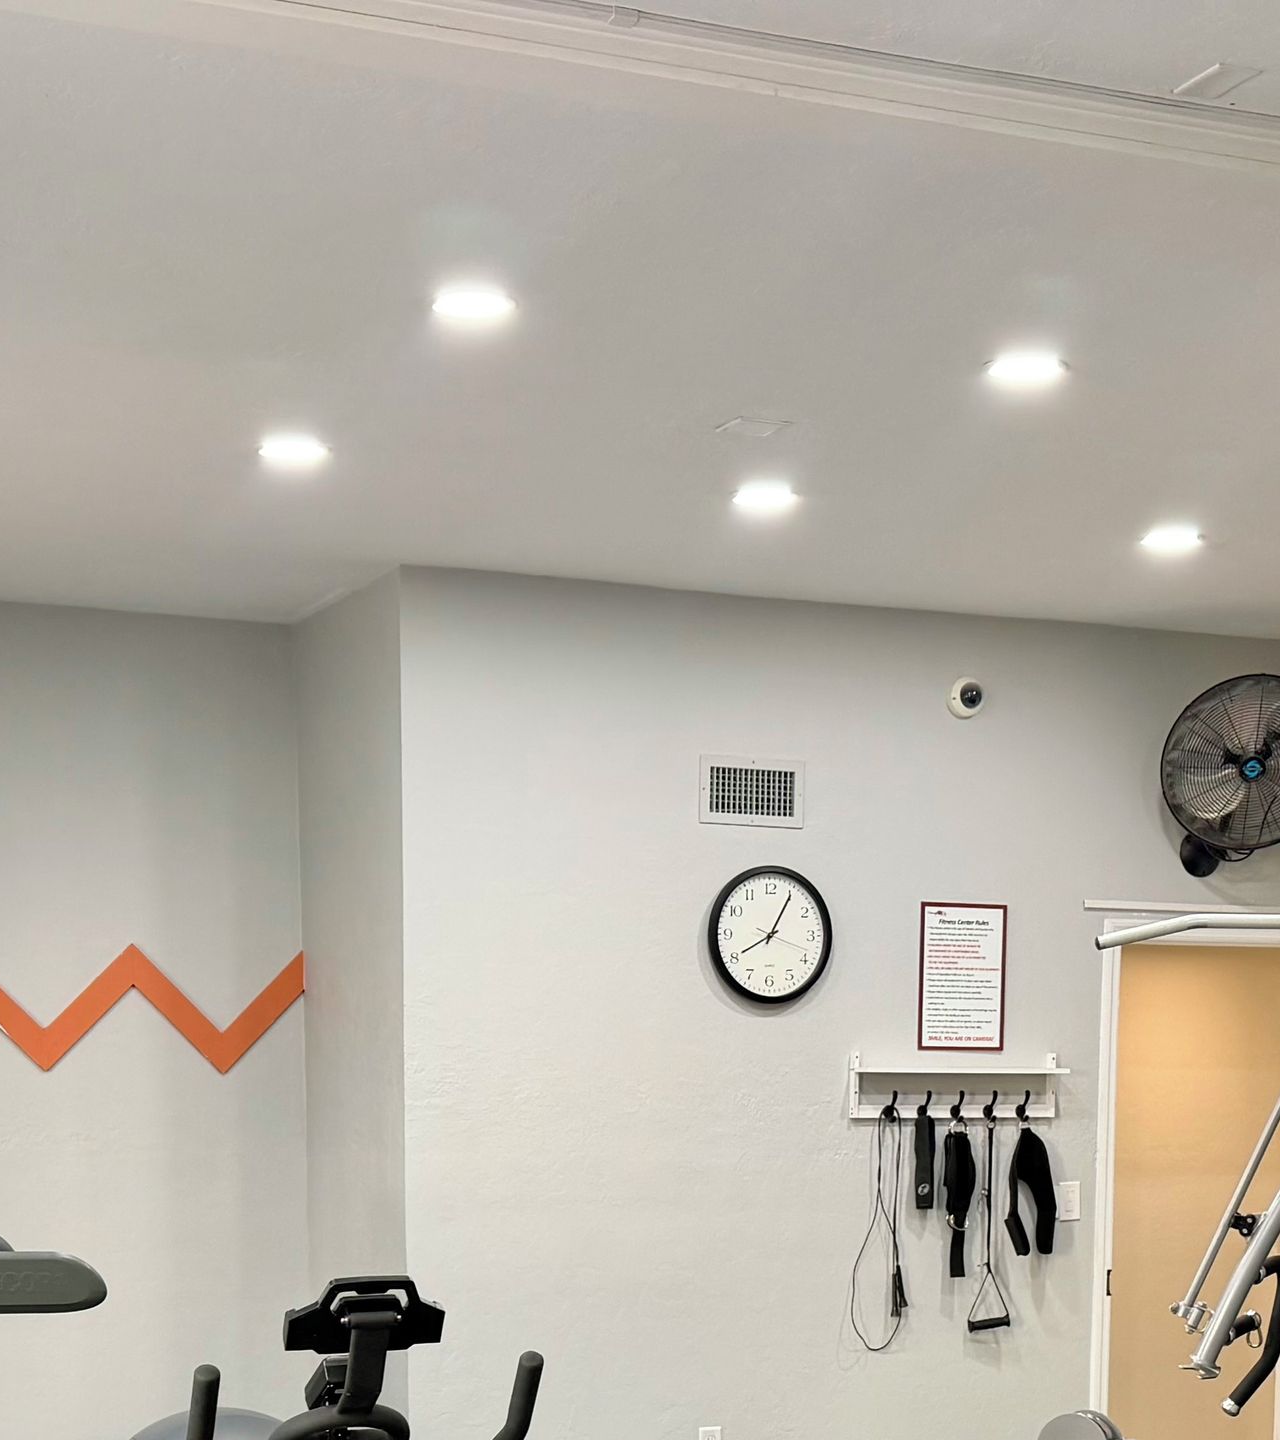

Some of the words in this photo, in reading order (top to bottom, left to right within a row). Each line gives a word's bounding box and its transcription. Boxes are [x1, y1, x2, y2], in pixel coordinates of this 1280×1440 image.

[745, 889, 754, 901] 11
[765, 883, 777, 895] 12
[730, 905, 743, 917] 10
[800, 907, 809, 919] 2
[723, 928, 733, 940] 9
[806, 930, 816, 942] 3
[730, 952, 739, 964] 8
[799, 953, 809, 965] 4
[745, 969, 755, 980] 7
[784, 969, 794, 981] 5
[764, 975, 774, 987] 6
